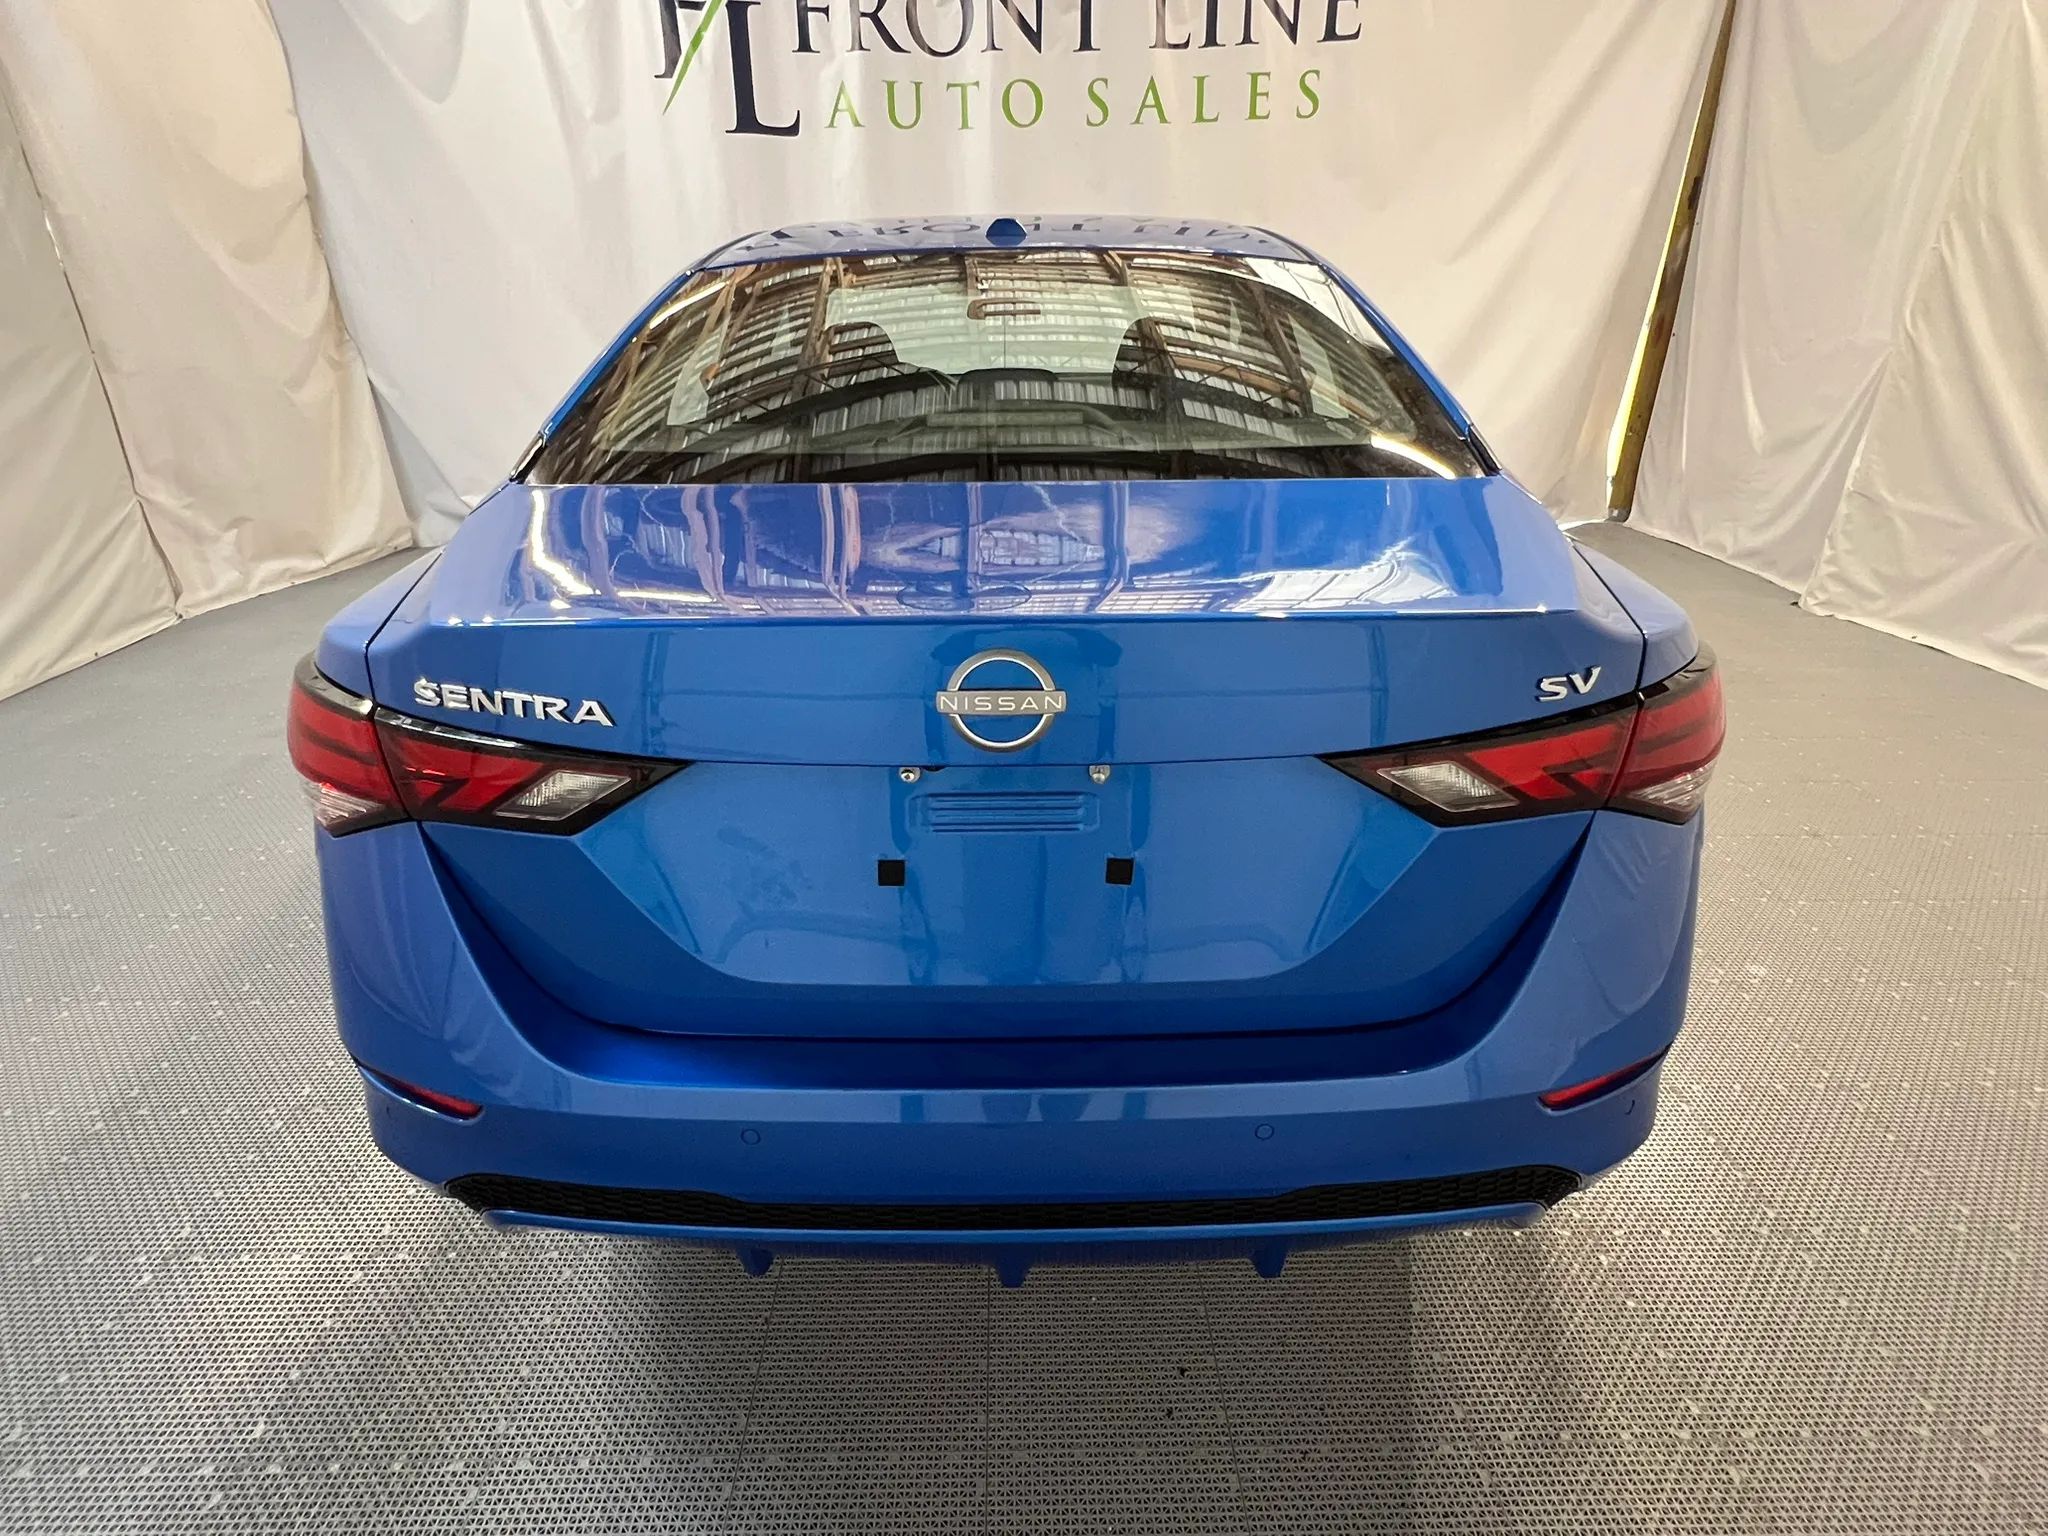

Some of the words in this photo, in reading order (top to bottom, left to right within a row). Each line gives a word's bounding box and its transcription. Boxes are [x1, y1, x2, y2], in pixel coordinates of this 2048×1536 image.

[824, 78, 1044, 131] AUTO
[1086, 69, 1321, 127] SALES
[413, 677, 615, 727] SENTRA
[940, 694, 1063, 712] NISSAN
[1537, 665, 1602, 702] SV
